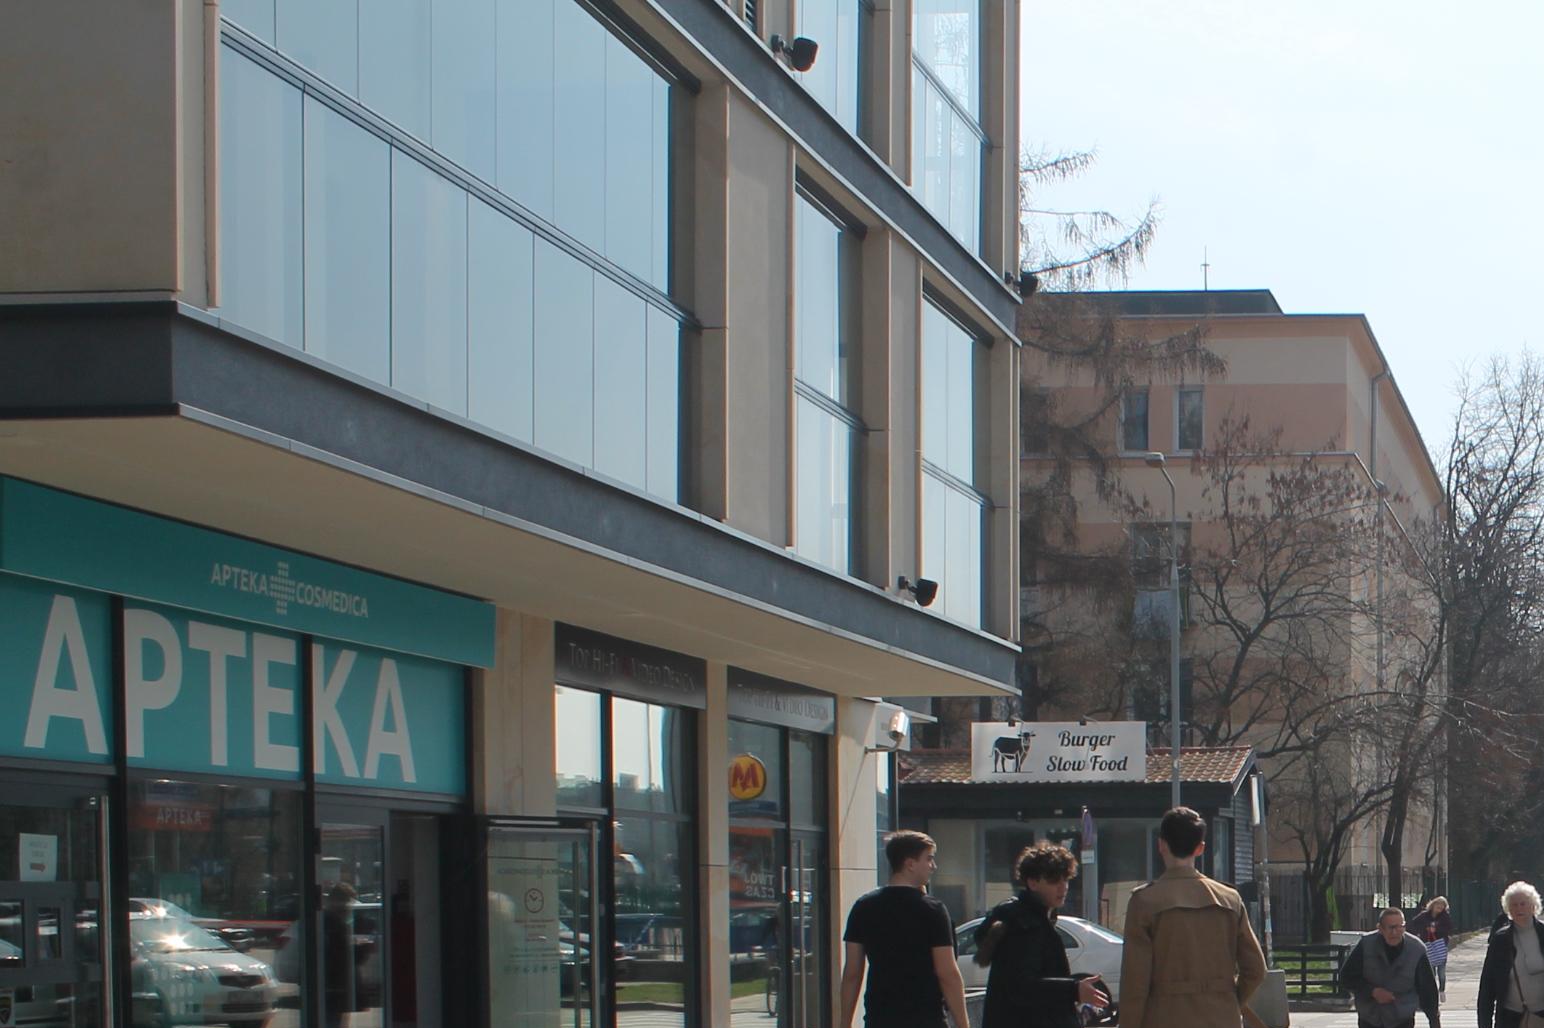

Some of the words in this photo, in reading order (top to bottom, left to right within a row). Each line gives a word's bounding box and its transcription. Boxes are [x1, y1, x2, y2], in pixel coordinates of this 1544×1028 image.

[211, 563, 269, 596] APTEKA
[296, 581, 369, 618] COSMEDICA
[24, 594, 417, 783] APTEKA
[1058, 730, 1116, 752] Burger
[1046, 755, 1086, 772] Slow
[1089, 755, 1129, 772] Food
[157, 809, 202, 826] APTEKA
